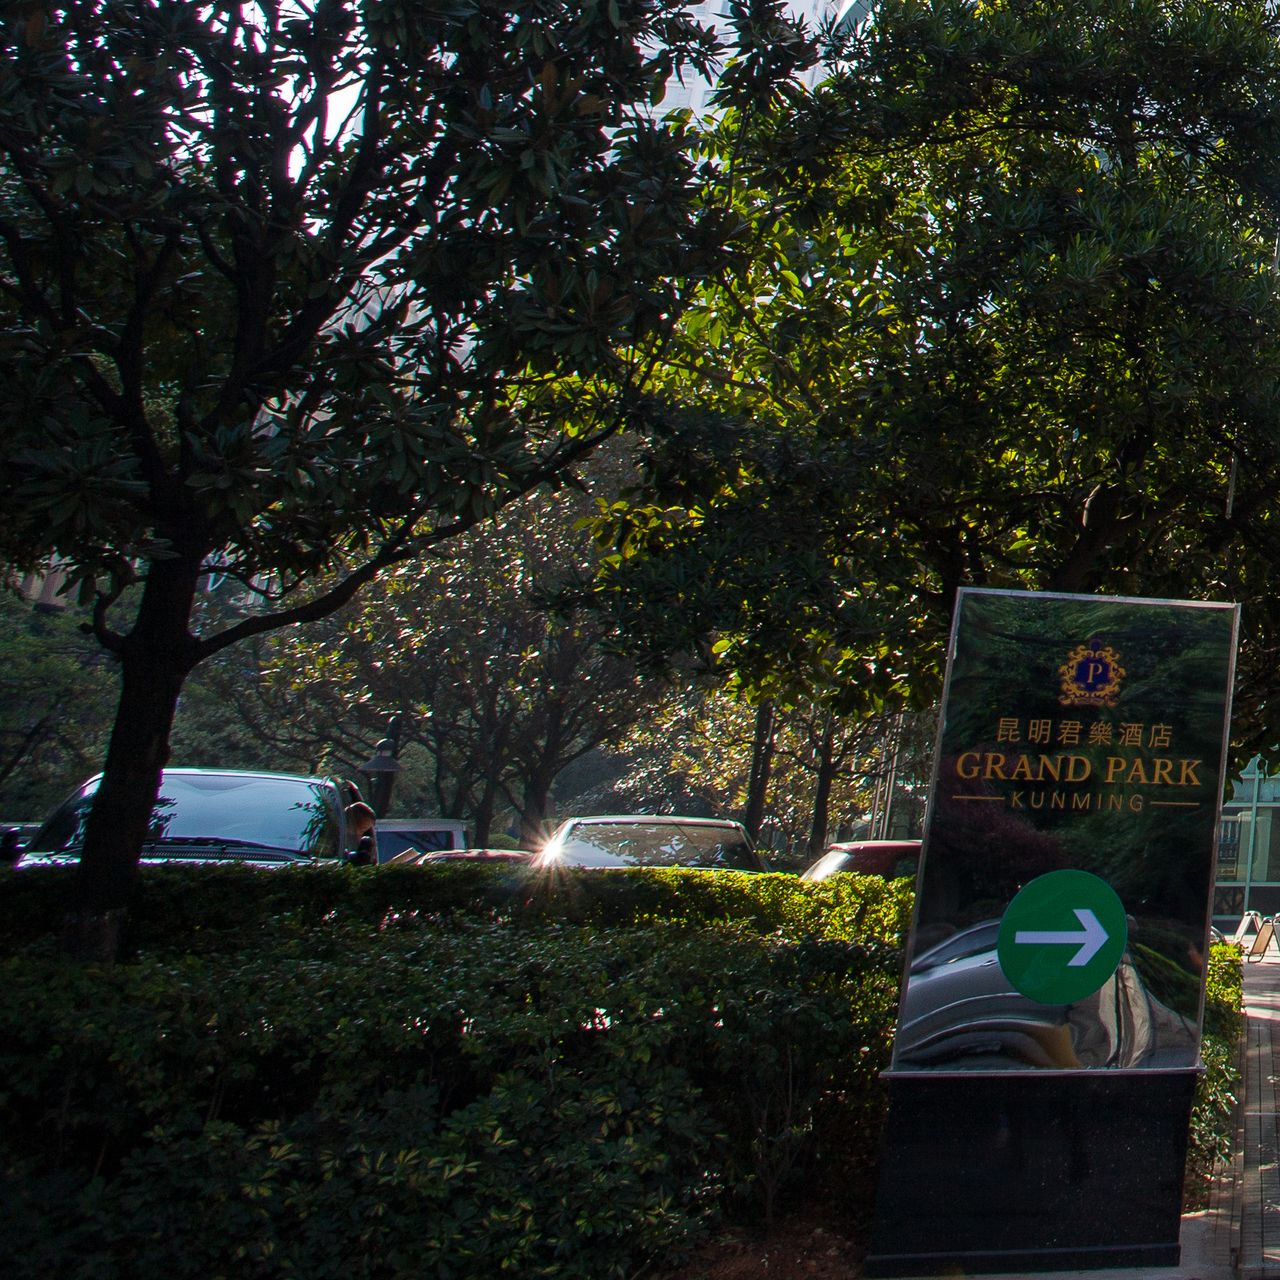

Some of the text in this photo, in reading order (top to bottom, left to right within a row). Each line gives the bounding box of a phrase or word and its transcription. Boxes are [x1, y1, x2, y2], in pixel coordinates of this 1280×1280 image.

[1087, 663, 1103, 684] P
[996, 717, 1173, 748] 昆明君樂酒店
[956, 752, 1203, 786] GRAND PARK
[1011, 791, 1145, 813] KUNMING
